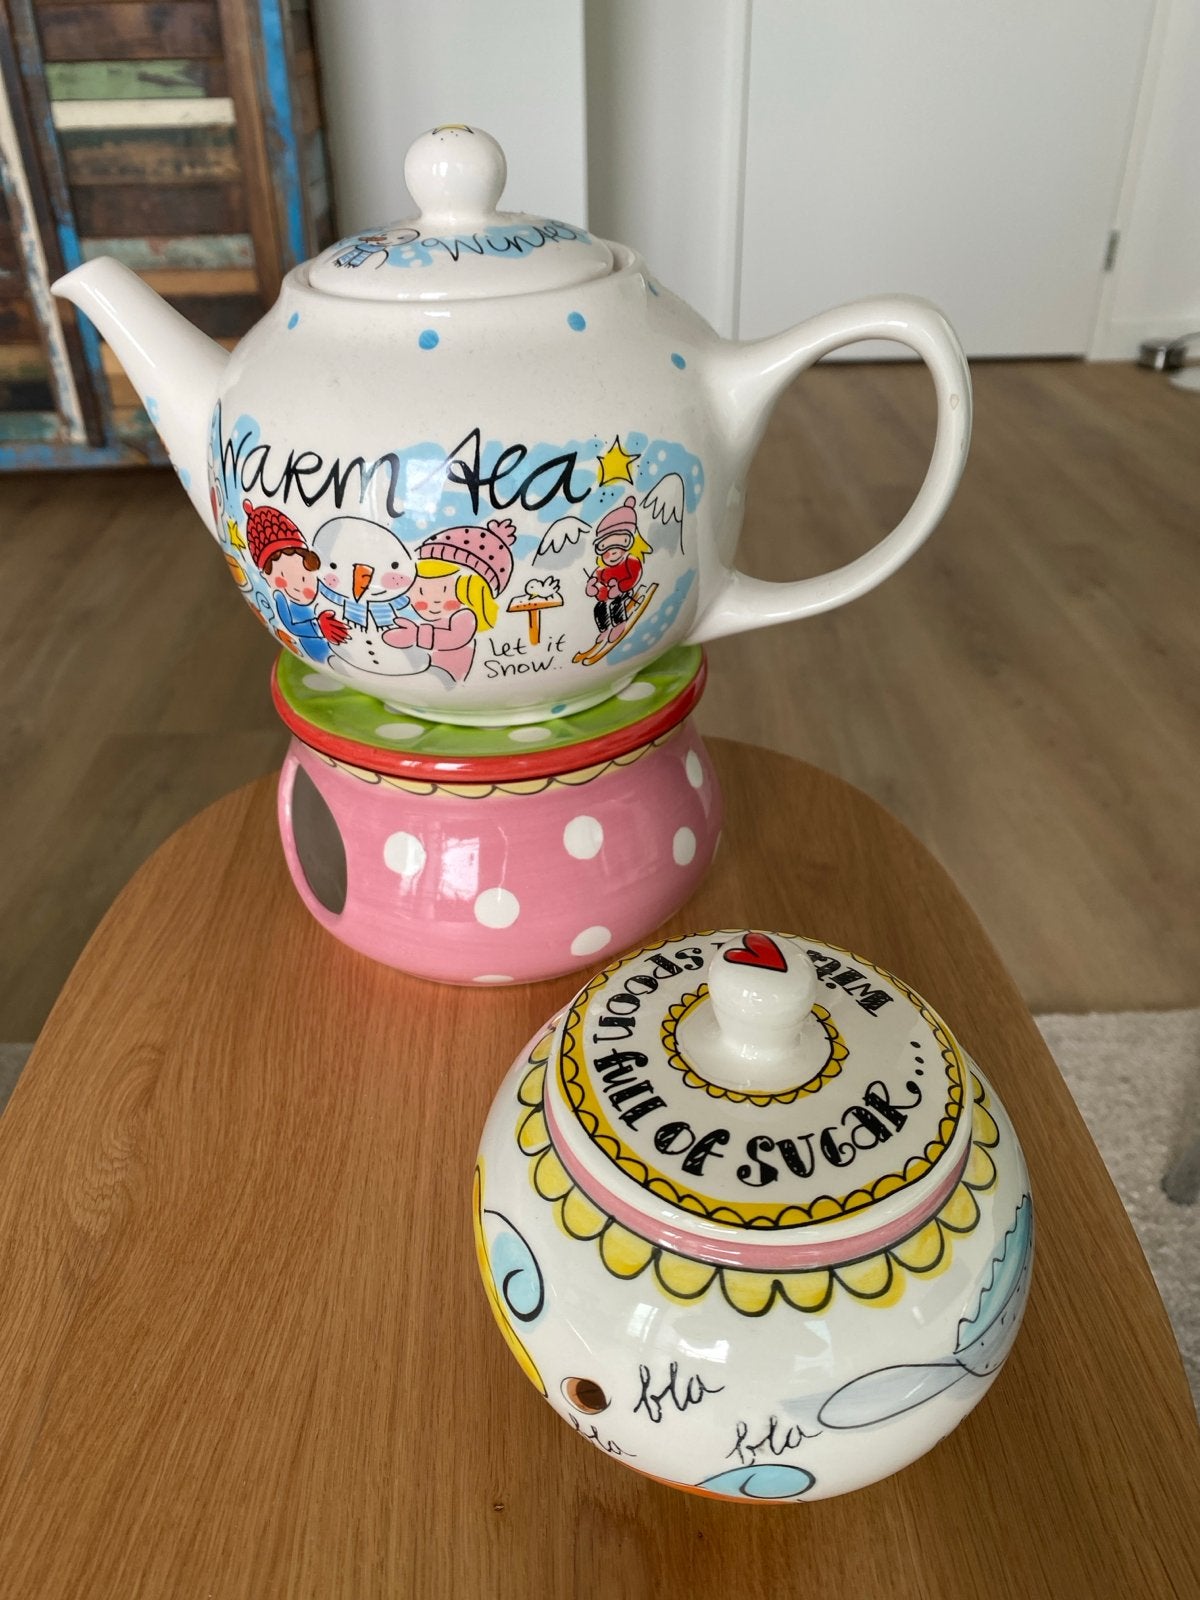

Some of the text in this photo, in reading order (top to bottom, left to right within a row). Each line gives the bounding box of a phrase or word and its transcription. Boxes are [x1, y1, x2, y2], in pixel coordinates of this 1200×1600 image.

[446, 427, 592, 516] tea
[546, 633, 567, 653] it
[632, 1360, 726, 1424] bla
[724, 1414, 824, 1465] bla
